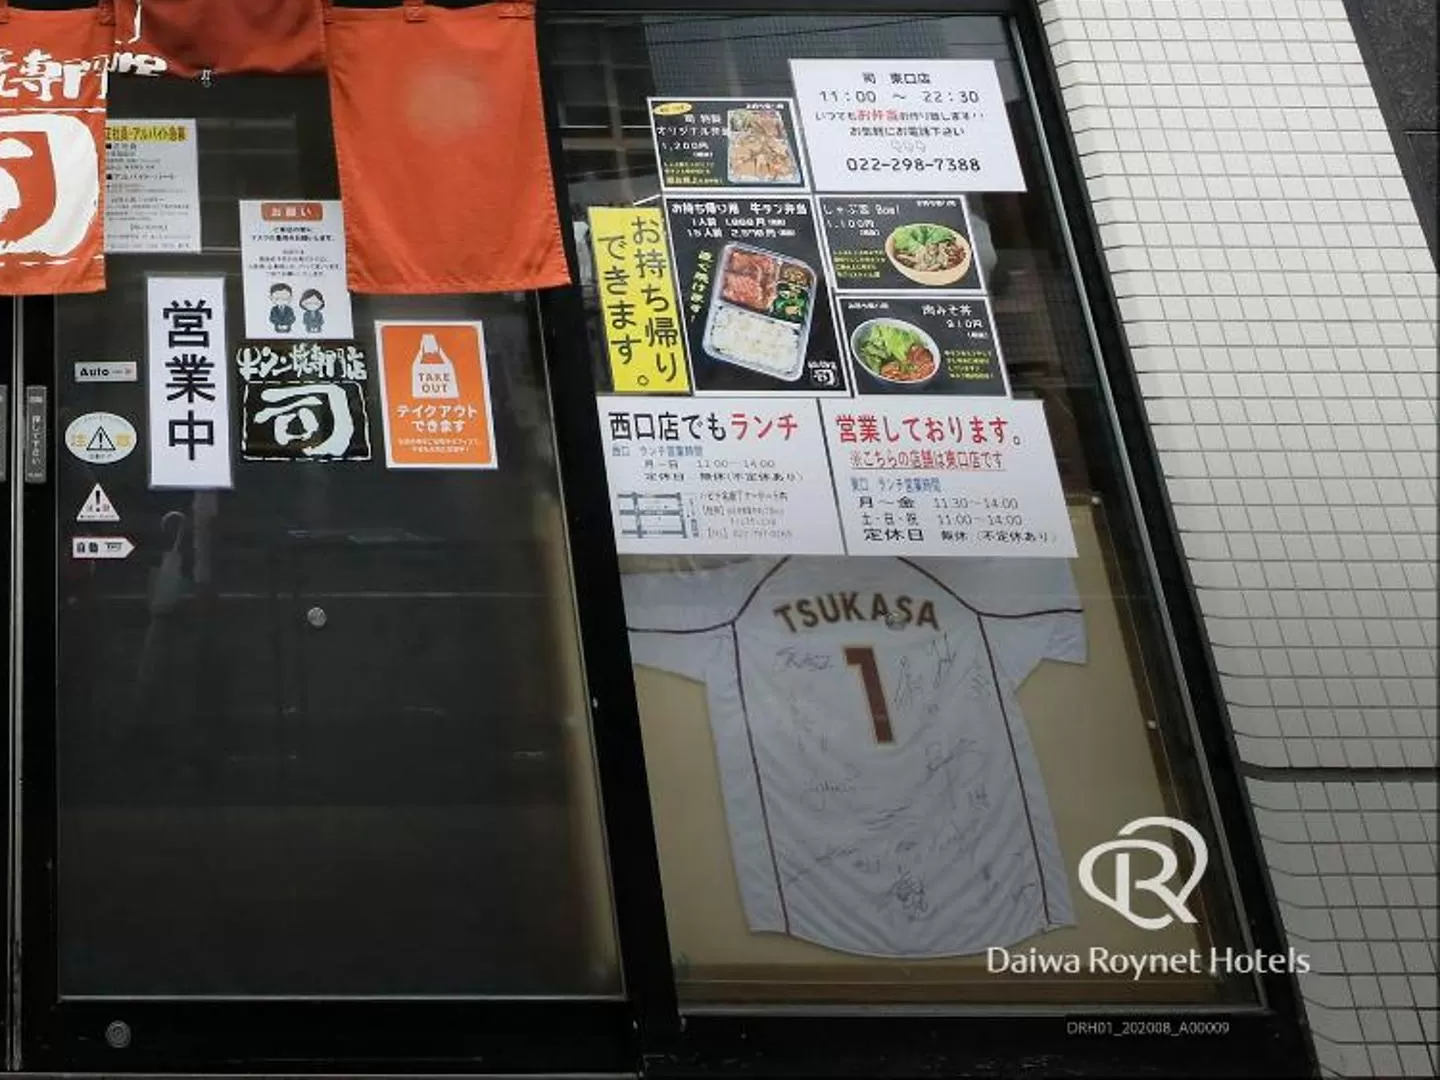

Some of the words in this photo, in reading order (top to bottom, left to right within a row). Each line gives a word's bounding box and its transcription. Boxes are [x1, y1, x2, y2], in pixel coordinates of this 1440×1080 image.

[890, 72, 931, 84] 東口店
[846, 157, 981, 172] 022-298-7388
[597, 234, 650, 387] できます。
[631, 216, 679, 383] お持ち帰り
[162, 299, 217, 462] 営業中
[418, 372, 450, 382] TAKE
[421, 383, 448, 393] OUT
[254, 384, 354, 457] 司
[396, 404, 478, 419] テイクアウト
[412, 419, 466, 433] できます
[608, 411, 798, 442] 西口店でもランチ
[836, 414, 1021, 446] 営業しております。
[863, 527, 925, 542] 定休日
[772, 591, 940, 633] TSUKASA
[843, 645, 894, 743] 1
